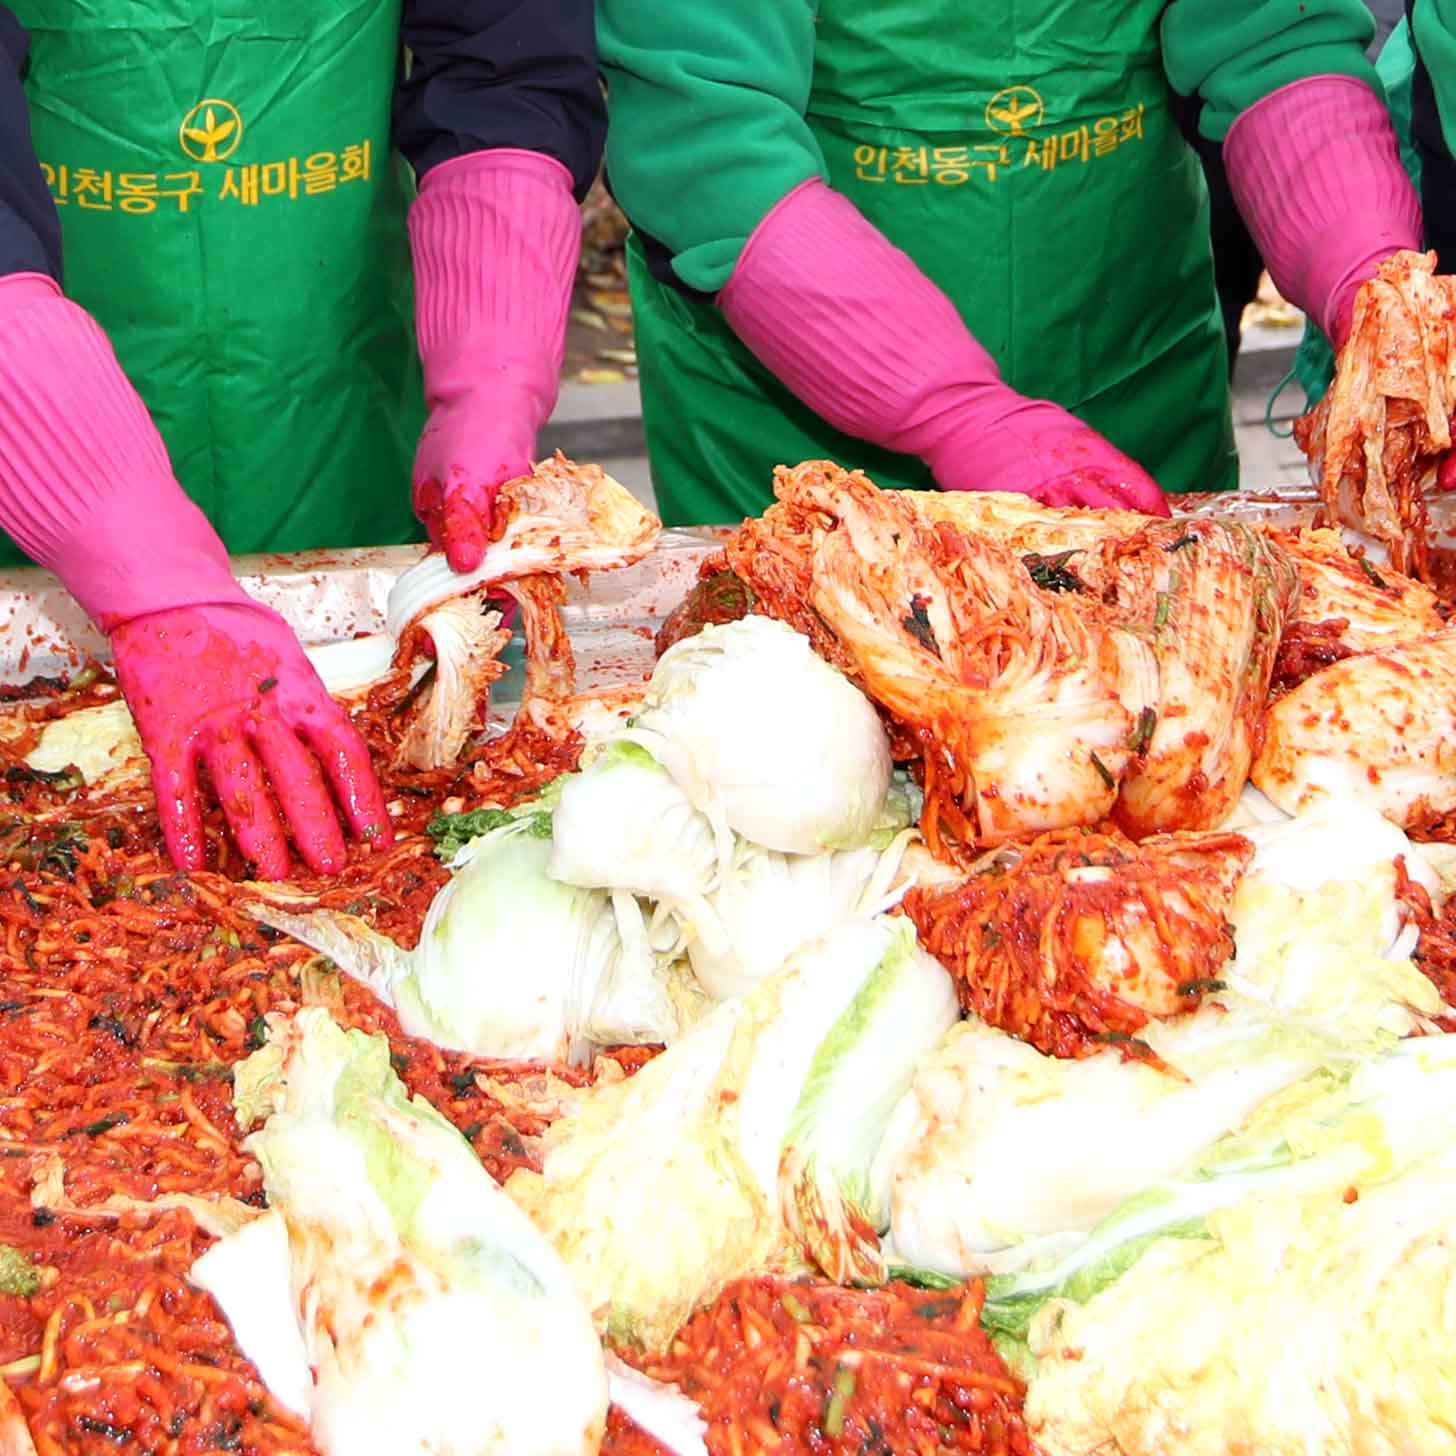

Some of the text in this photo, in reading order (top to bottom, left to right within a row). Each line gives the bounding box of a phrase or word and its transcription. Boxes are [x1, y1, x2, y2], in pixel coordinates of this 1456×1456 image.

[39, 139, 371, 214] 인천동구 새마을회
[853, 101, 1145, 185] 인천동구 새마을회
